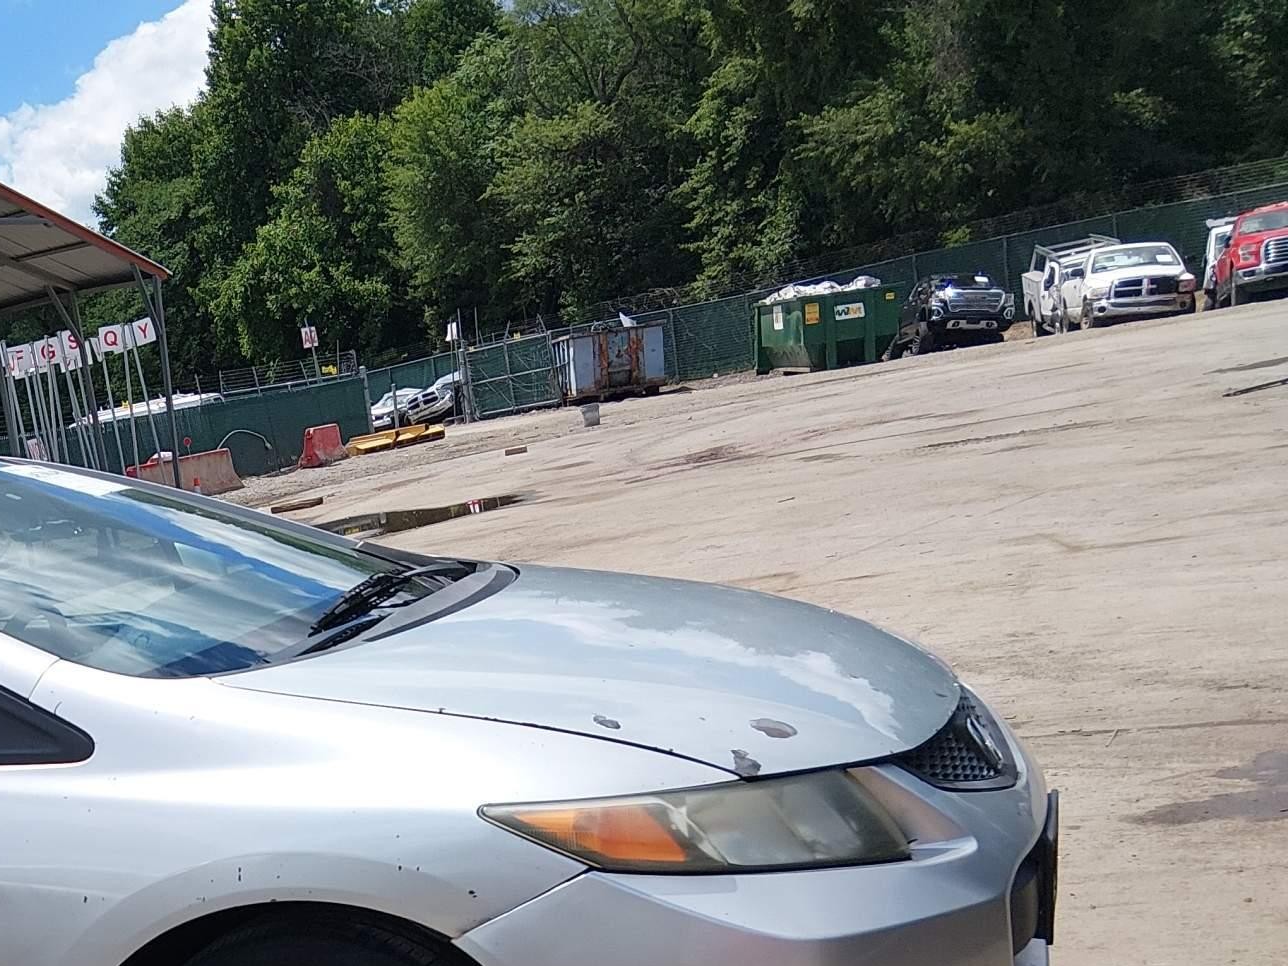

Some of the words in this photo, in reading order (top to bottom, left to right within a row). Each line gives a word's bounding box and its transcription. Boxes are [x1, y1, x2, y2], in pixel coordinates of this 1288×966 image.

[103, 330, 118, 346] Q
[137, 322, 148, 339] Y
[40, 343, 56, 360] G
